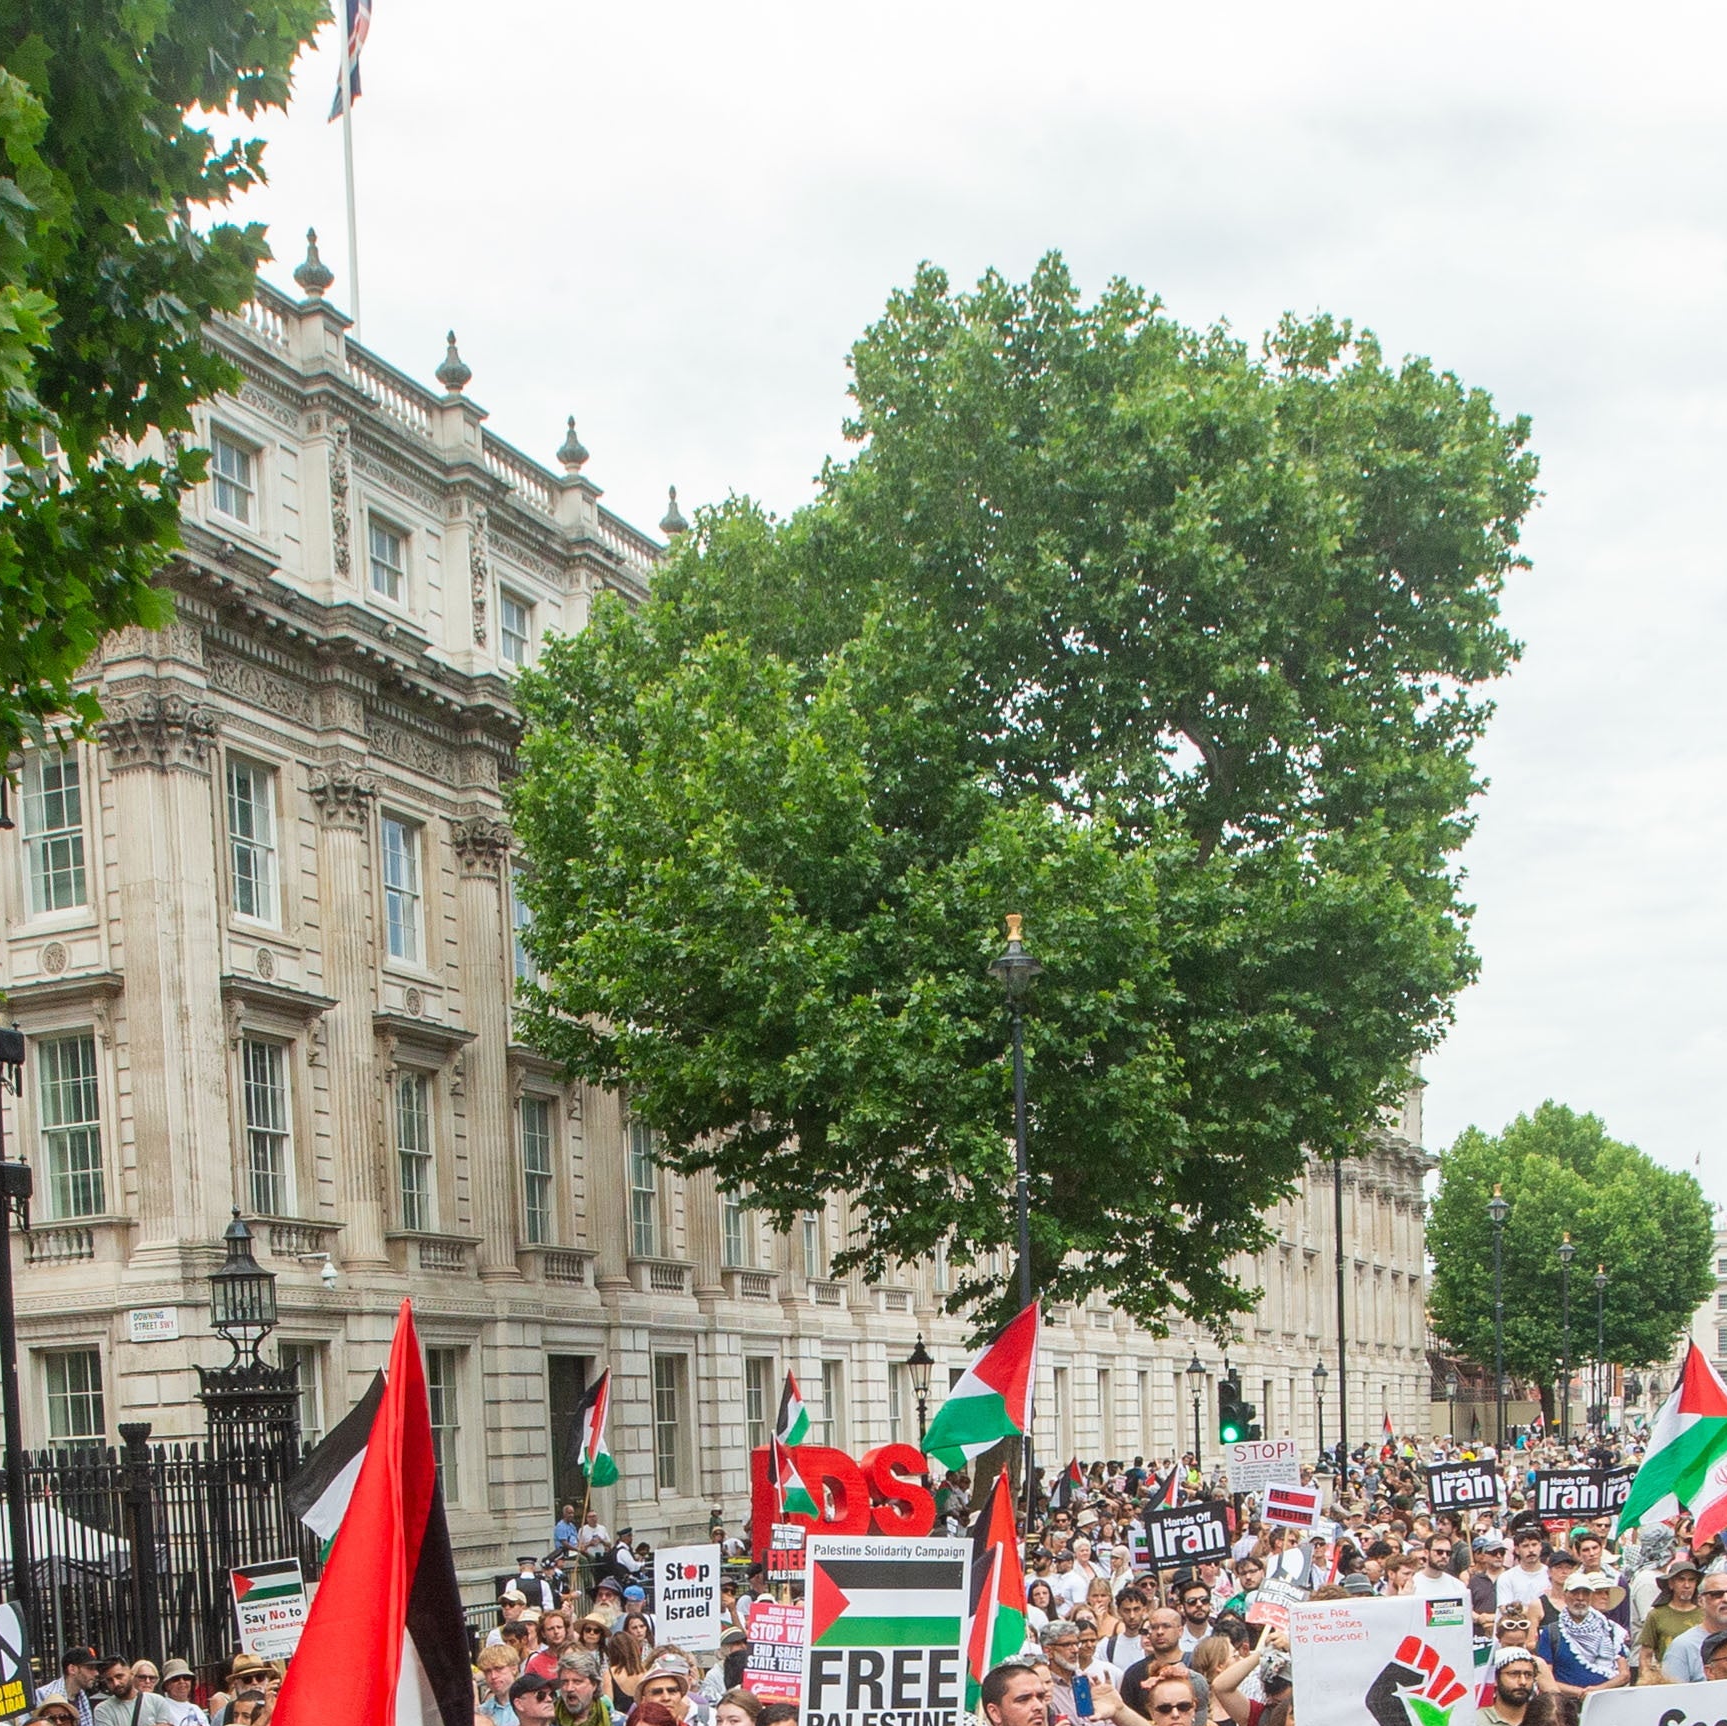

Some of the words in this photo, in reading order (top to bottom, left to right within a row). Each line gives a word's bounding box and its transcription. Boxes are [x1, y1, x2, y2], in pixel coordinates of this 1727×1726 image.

[133, 1311, 164, 1321] DOWNING
[134, 1321, 157, 1331] STREET
[159, 1320, 174, 1329] SW1
[1234, 1442, 1294, 1462] STOP!
[1432, 1475, 1493, 1503] Iran
[1539, 1481, 1598, 1509] Iran
[1602, 1481, 1631, 1508] Ira
[1164, 1515, 1194, 1528] Hands
[1196, 1511, 1211, 1523] Off
[1151, 1520, 1225, 1558] Iran
[767, 1550, 805, 1570] FREE
[814, 1544, 862, 1556] Palestine
[864, 1545, 911, 1559] Solidarity
[915, 1545, 965, 1559] Campaign
[666, 1563, 709, 1582] Stop
[663, 1584, 713, 1600] Arming
[244, 1613, 266, 1625] Say
[269, 1610, 286, 1620] No
[289, 1608, 302, 1617] to
[666, 1602, 710, 1620] Israel
[750, 1623, 783, 1641] STOP
[787, 1626, 804, 1643] WA
[754, 1643, 773, 1656] END
[775, 1645, 802, 1659] ISRAE
[747, 1655, 776, 1670] STATE
[777, 1658, 802, 1672] TERR
[807, 1649, 959, 1710] FREE
[2, 1680, 23, 1699] WAR
[5, 1694, 26, 1714] IRAN
